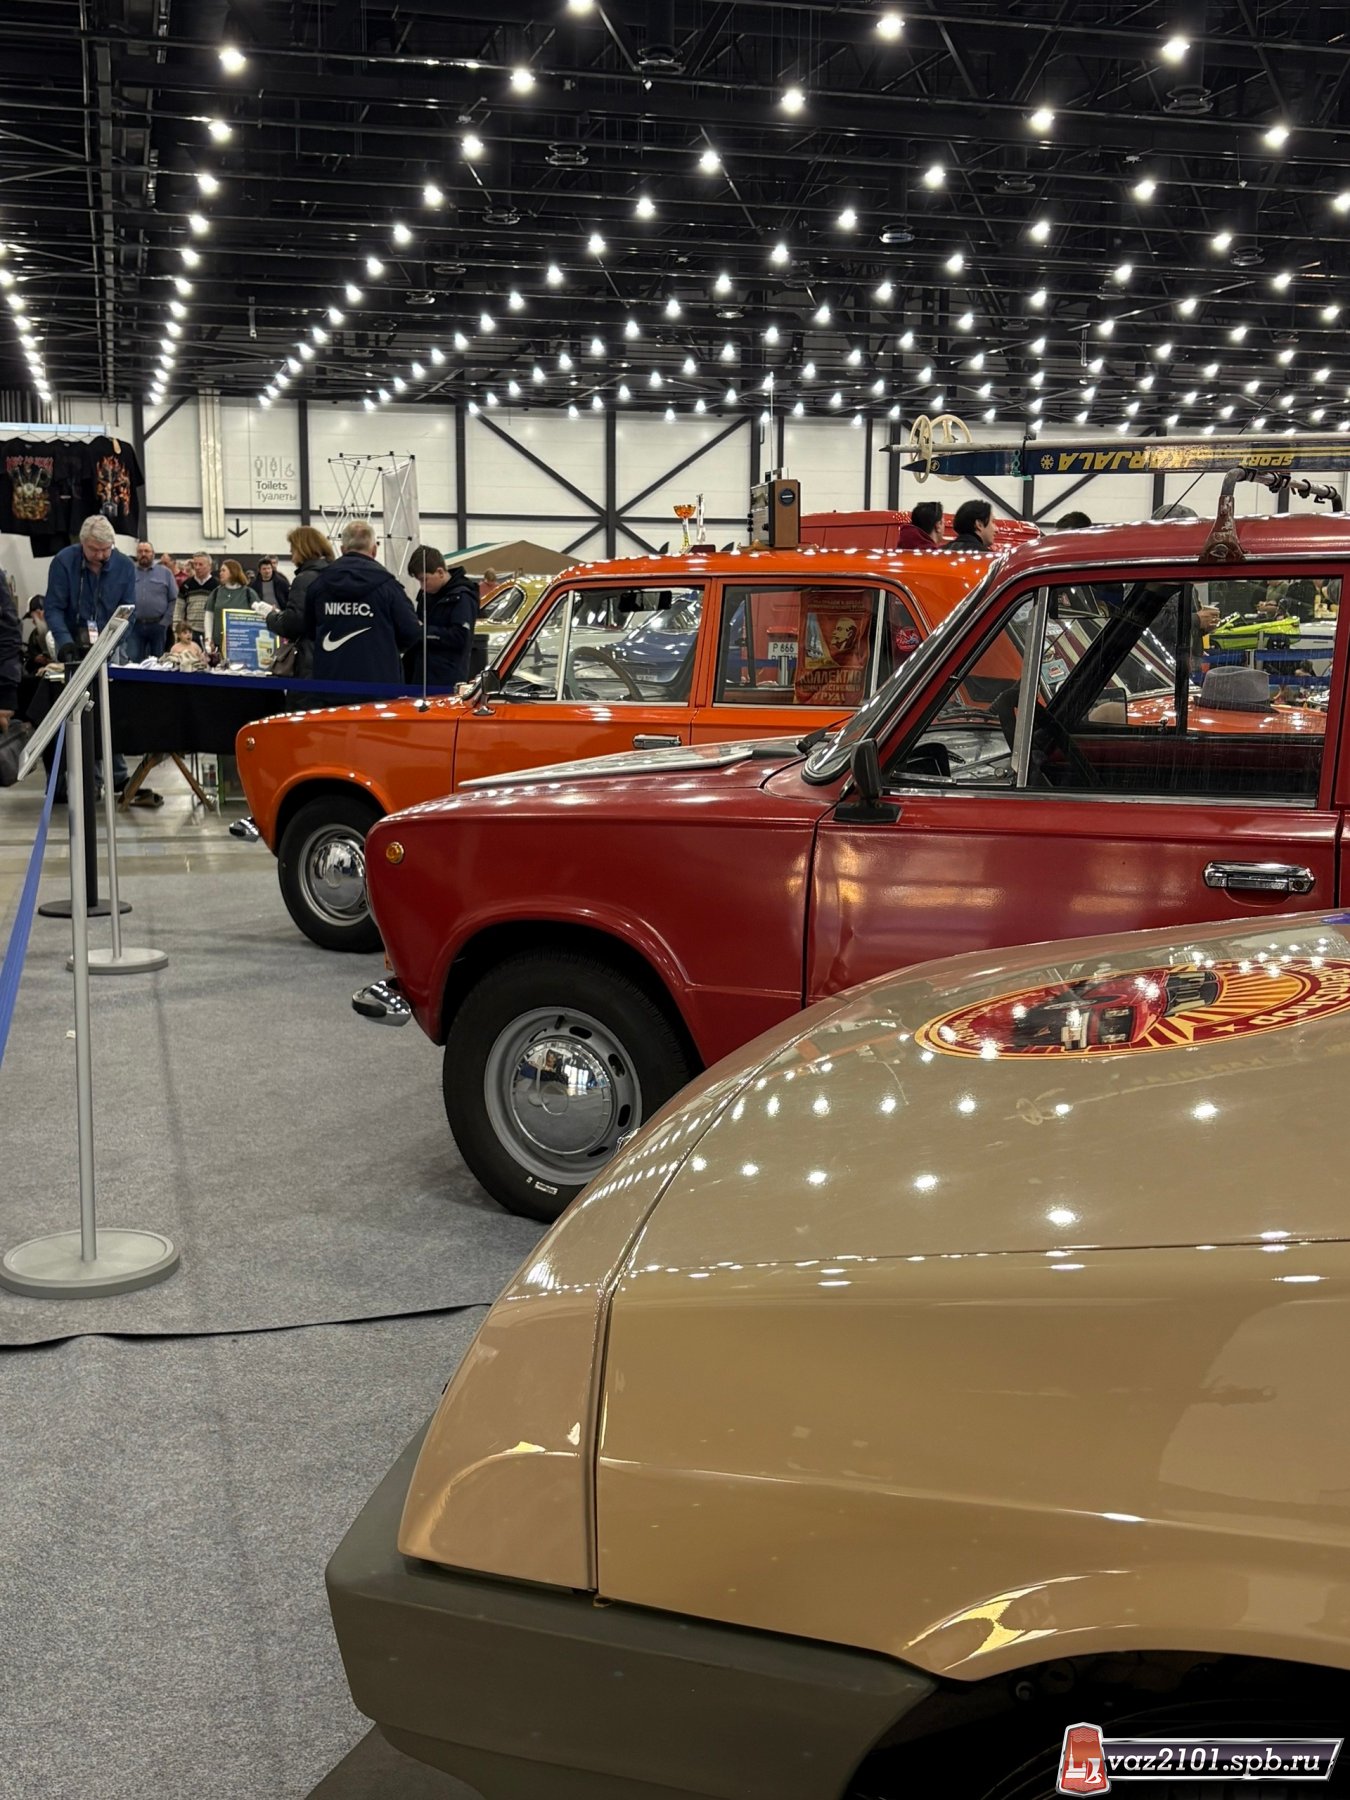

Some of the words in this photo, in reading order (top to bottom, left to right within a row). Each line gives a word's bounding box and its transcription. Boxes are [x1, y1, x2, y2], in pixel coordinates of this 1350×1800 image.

[1058, 450, 1184, 471] KARJALA
[1239, 454, 1295, 467] SPORT
[256, 480, 288, 490] Toilets
[256, 490, 297, 503] Туалеты
[325, 602, 352, 615] NIKE
[352, 602, 374, 617] F.C.
